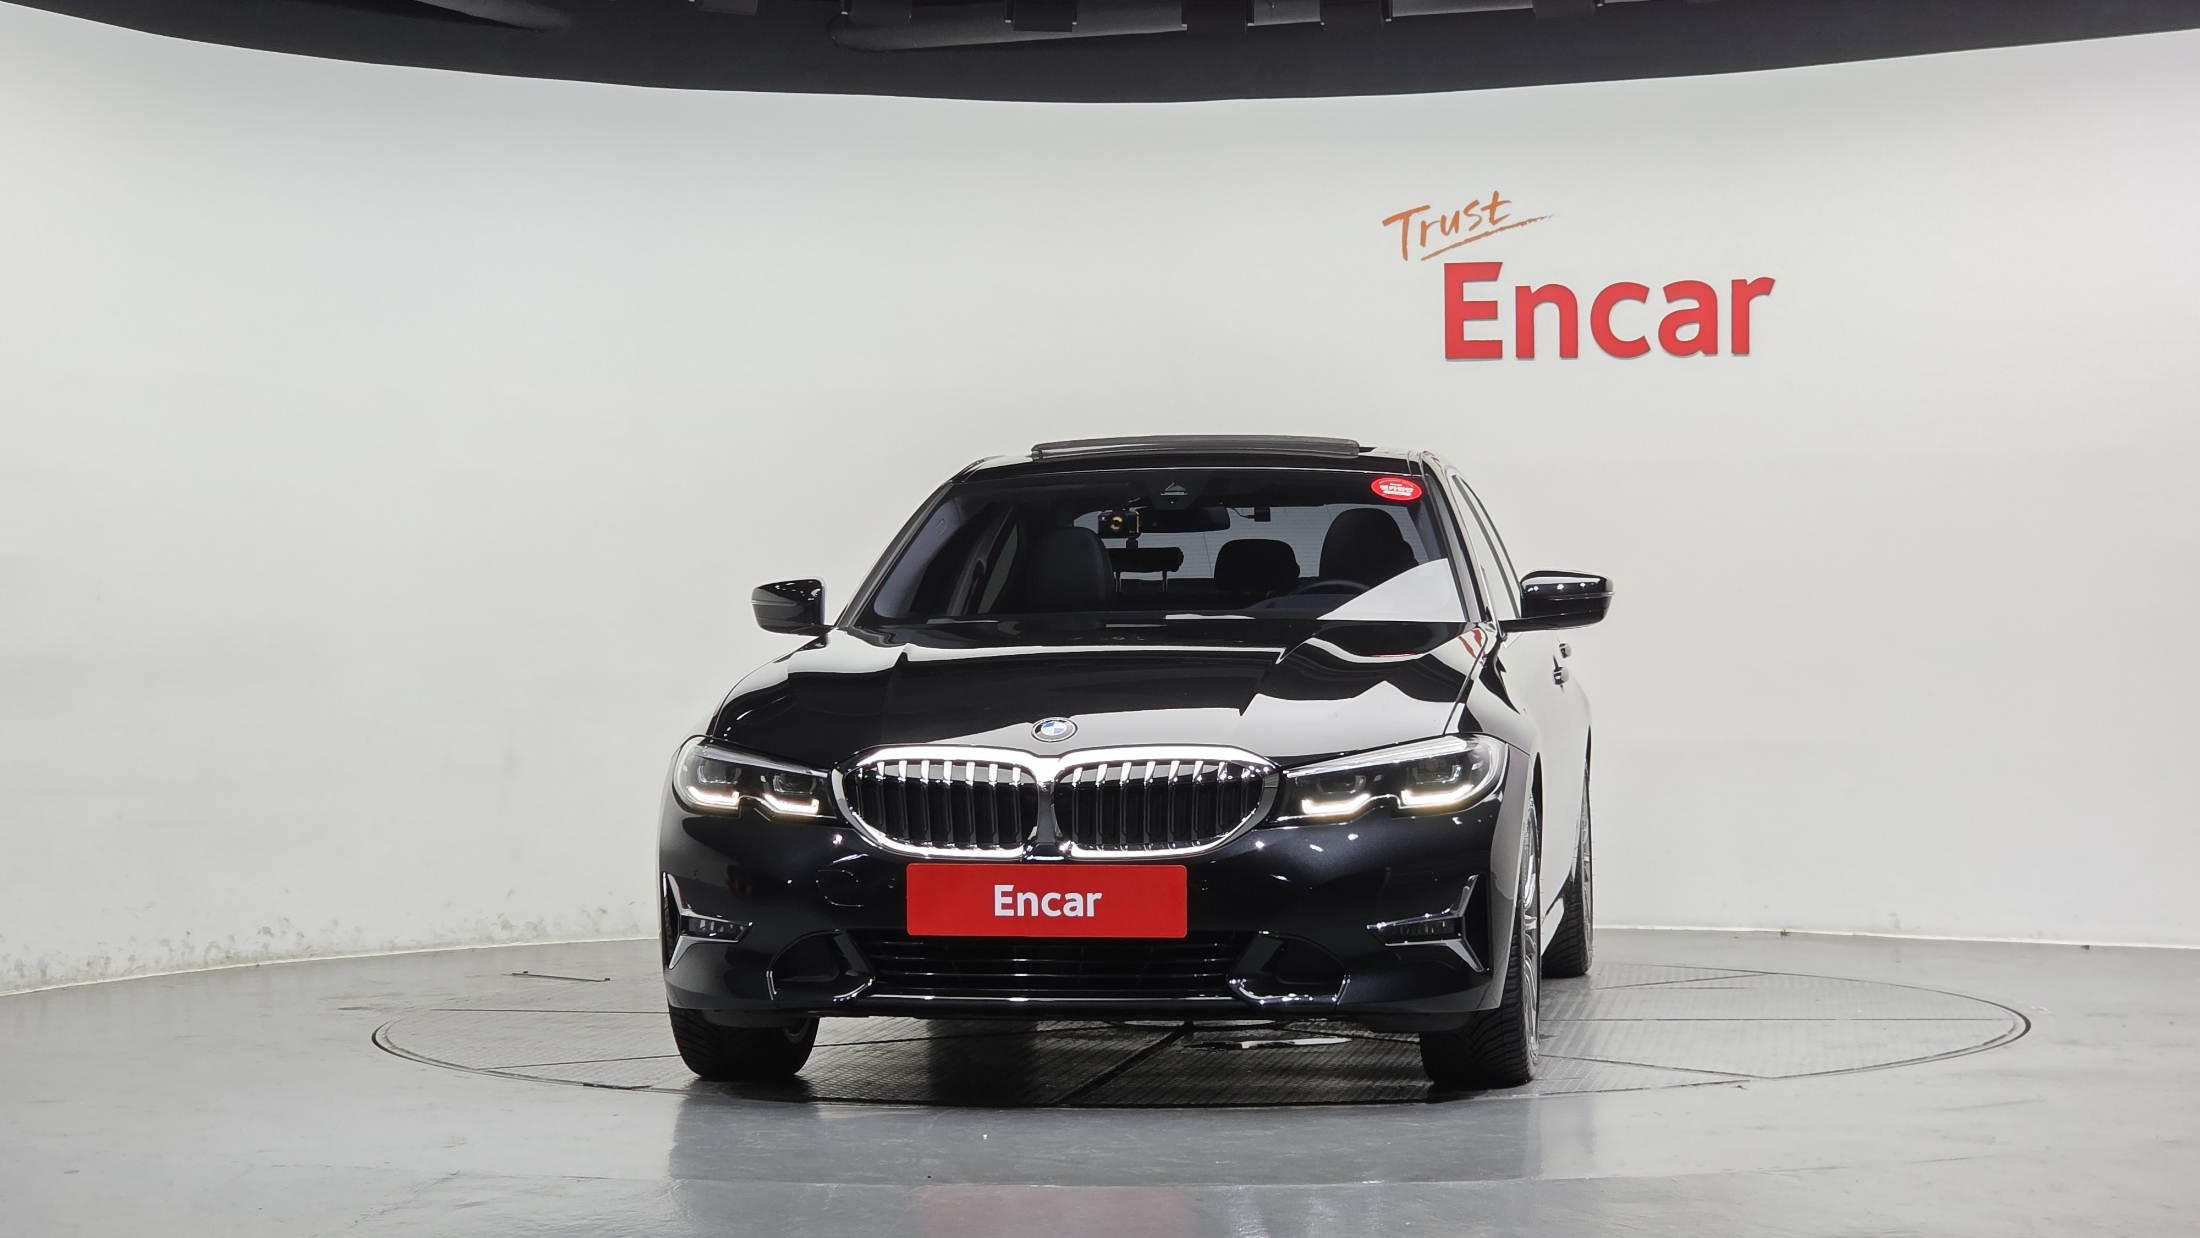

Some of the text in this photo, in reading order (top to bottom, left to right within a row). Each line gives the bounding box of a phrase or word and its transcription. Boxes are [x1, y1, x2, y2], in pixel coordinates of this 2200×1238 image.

[1382, 191, 1511, 261] Trust
[1444, 261, 1775, 360] Encar
[993, 884, 1103, 918] Encar
